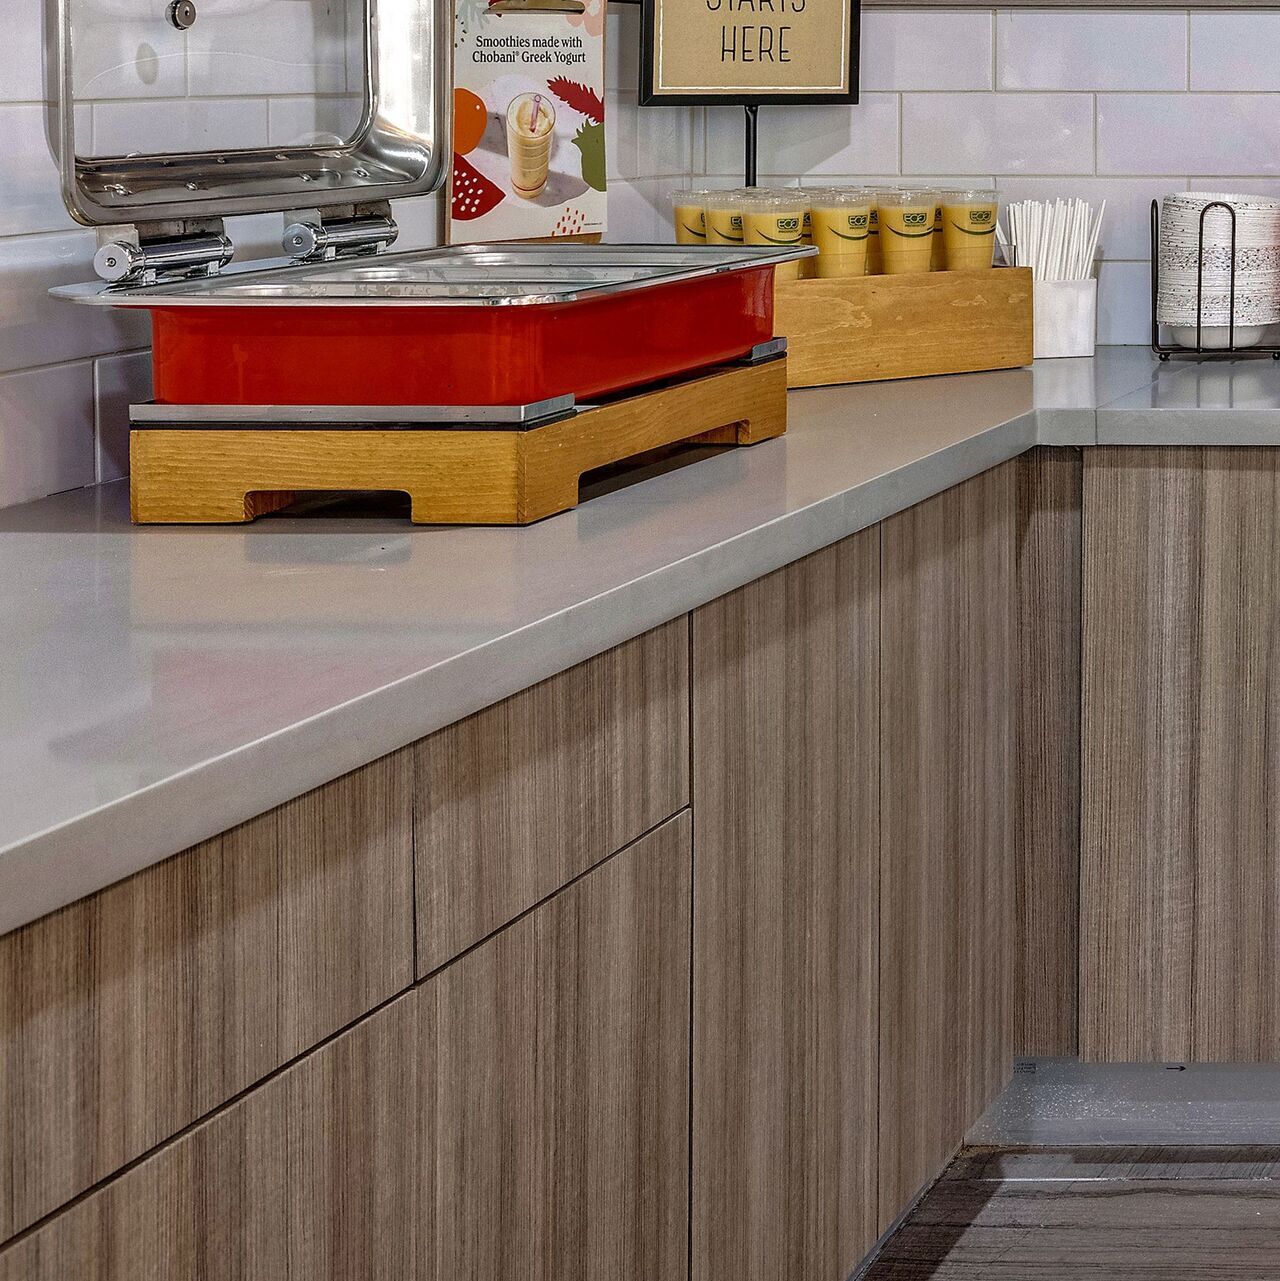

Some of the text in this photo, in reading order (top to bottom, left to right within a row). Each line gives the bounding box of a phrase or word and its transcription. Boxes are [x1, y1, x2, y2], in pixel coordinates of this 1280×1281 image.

[475, 35, 583, 49] Smoothies made with
[721, 25, 792, 63] HERE
[521, 50, 552, 63] Greek
[554, 51, 586, 66] Yogurt
